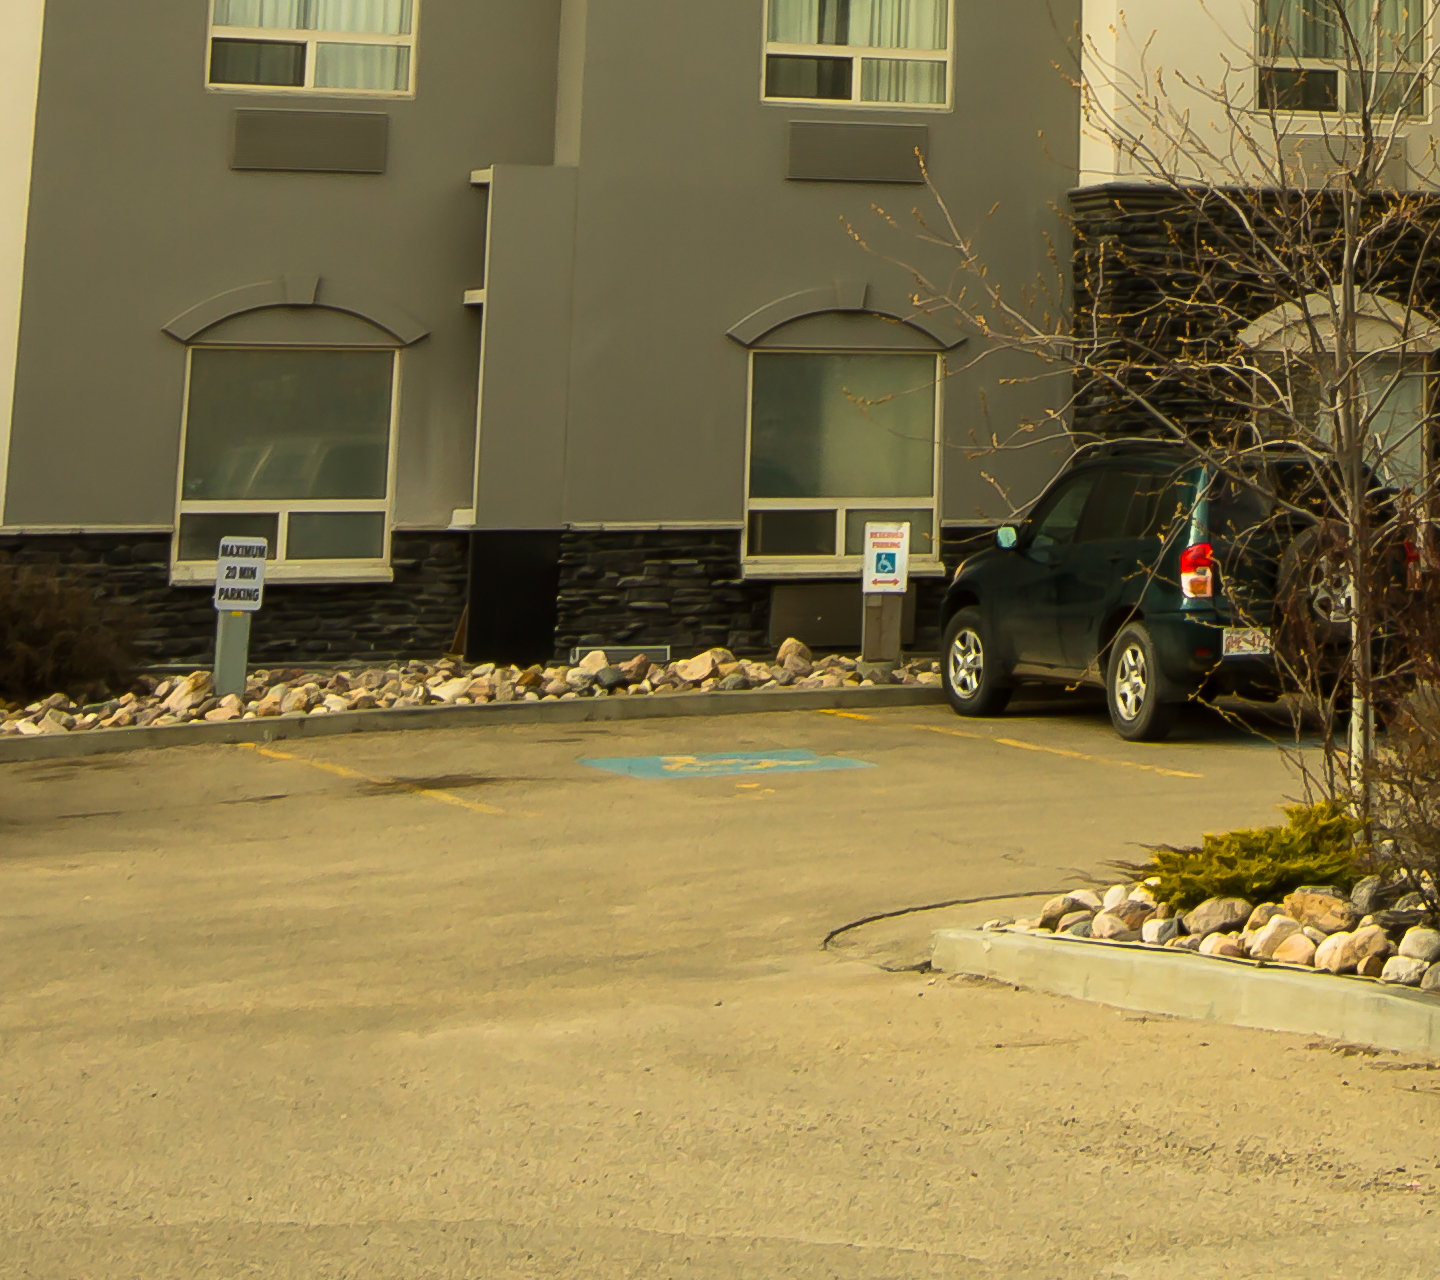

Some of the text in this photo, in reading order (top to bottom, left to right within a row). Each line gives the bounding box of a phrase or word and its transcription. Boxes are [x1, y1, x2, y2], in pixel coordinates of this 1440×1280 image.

[221, 544, 266, 558] MAXIMUM
[239, 566, 257, 579] MIN
[218, 587, 260, 601] PARKING
